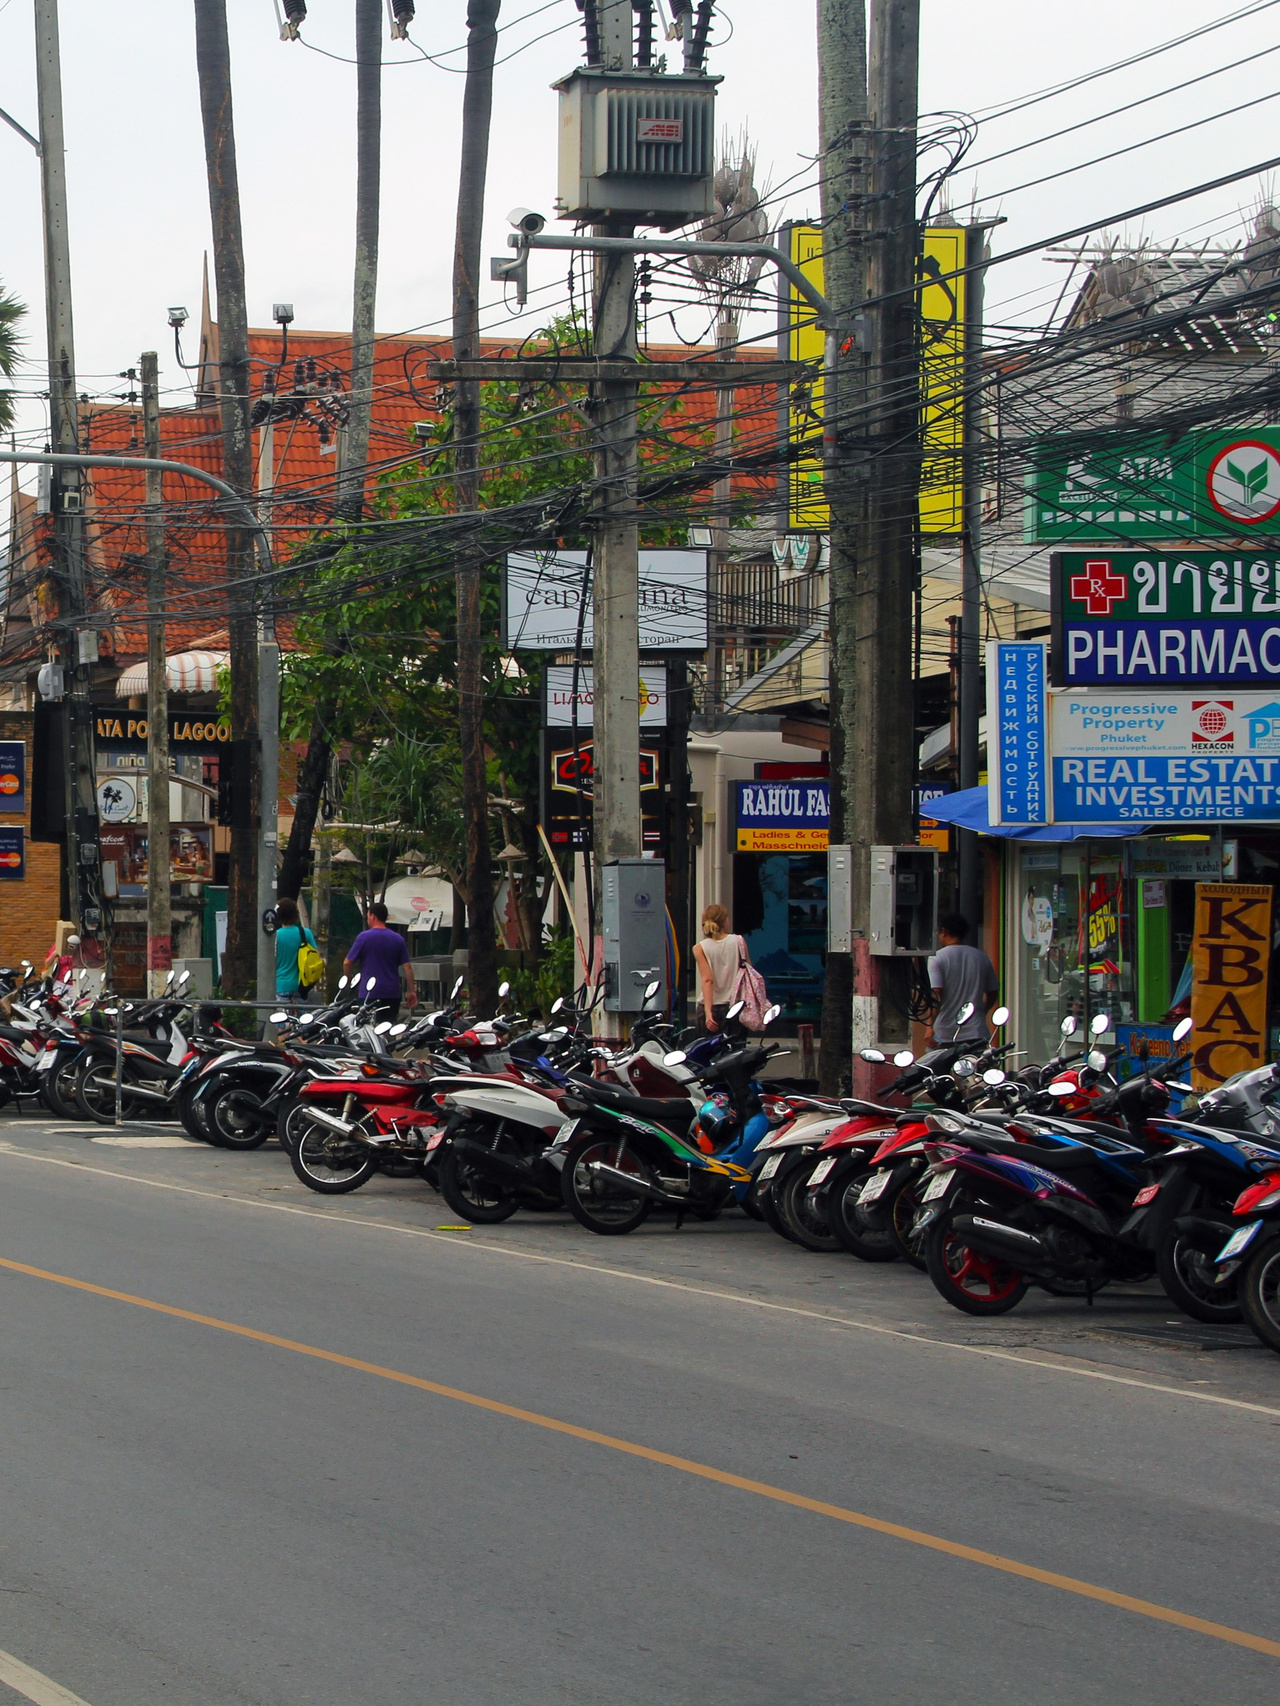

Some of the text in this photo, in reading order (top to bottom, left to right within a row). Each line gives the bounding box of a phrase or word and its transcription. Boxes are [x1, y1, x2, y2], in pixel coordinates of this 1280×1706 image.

[1118, 457, 1174, 481] ATM
[1026, 653, 1039, 724] РУССКИЙ
[1070, 702, 1178, 716] Progressive
[173, 721, 233, 742] LAGOO
[1003, 653, 1020, 814] НЕДВИЖИМОСТЬ
[1083, 716, 1165, 731] Property
[1100, 734, 1147, 743] Phuket
[1191, 742, 1234, 750] HEXACON
[1026, 730, 1039, 821] СОТРУДНИК
[1062, 759, 1157, 783] REAL
[742, 788, 803, 816] RAHUL
[1076, 785, 1280, 806] INVESTMENT
[1119, 807, 1245, 818] SALES OFFICE
[752, 831, 790, 840] Ladies
[795, 831, 806, 840] &
[1169, 861, 1193, 872] Döner
[1201, 884, 1271, 895] ХОЛОДНЫЙ
[1194, 896, 1269, 1084] КВАС
[1129, 1031, 1170, 1058] Kaeeno
